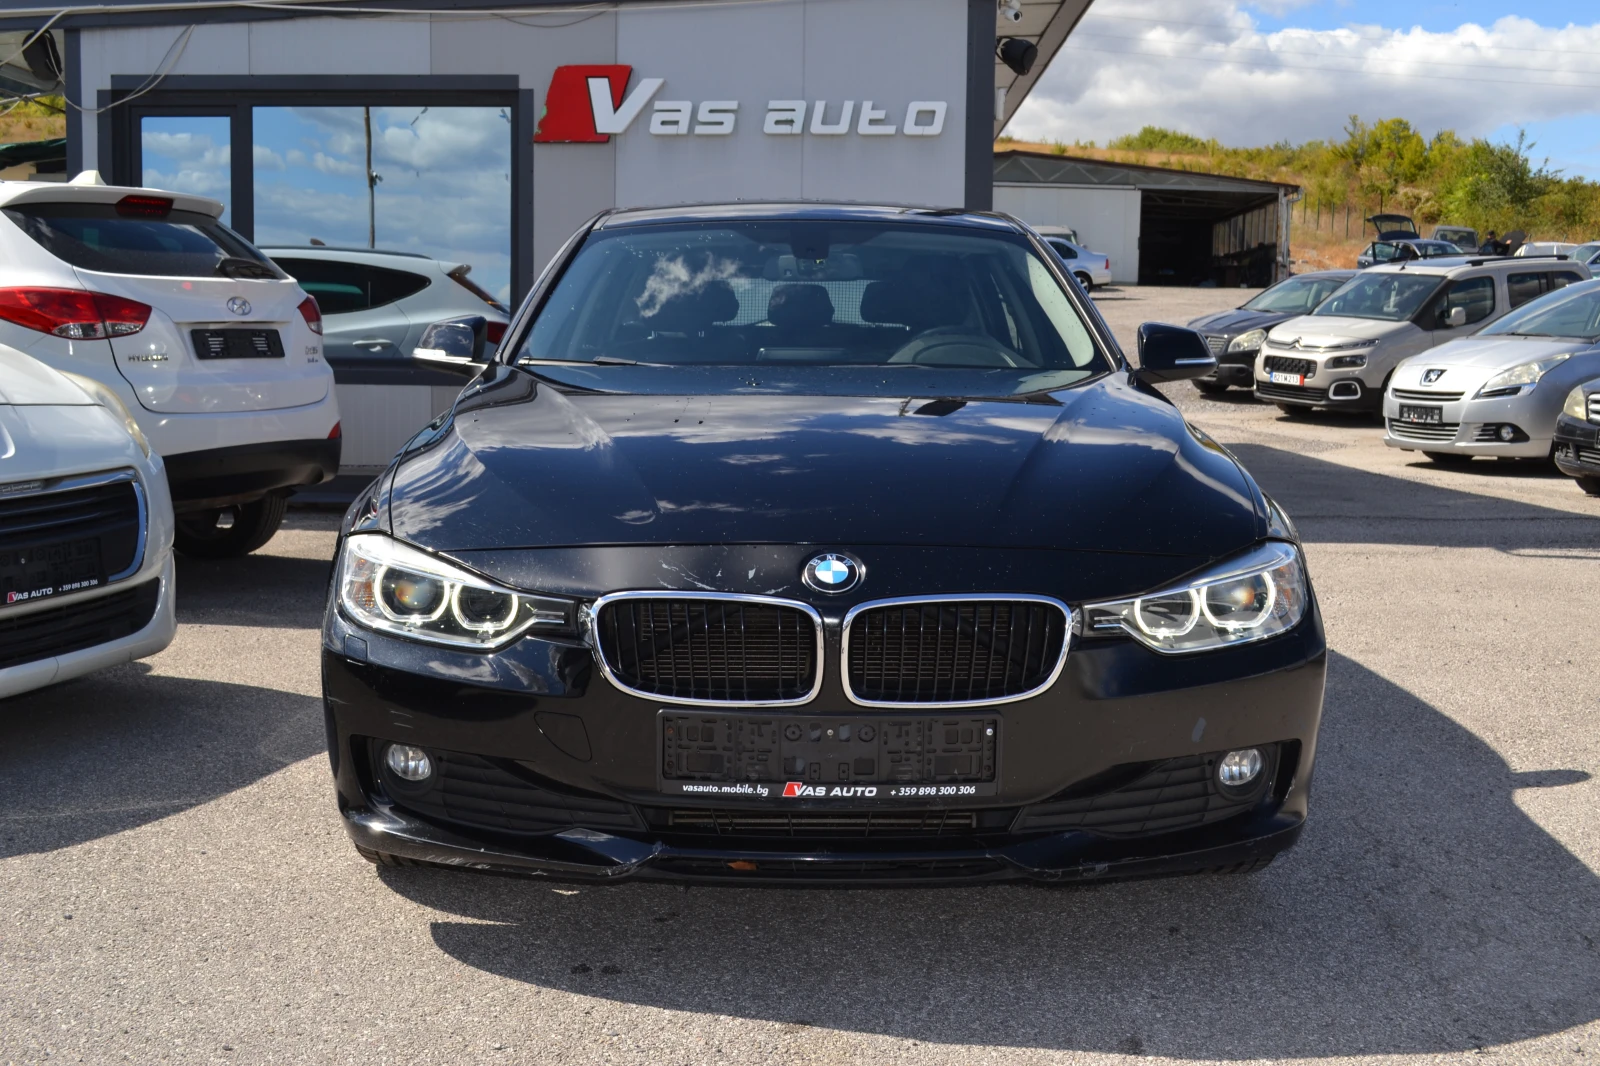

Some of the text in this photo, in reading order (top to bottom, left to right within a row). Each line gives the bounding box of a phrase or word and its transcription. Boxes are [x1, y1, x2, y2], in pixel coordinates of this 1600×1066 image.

[586, 77, 948, 136] Vas auto
[810, 554, 853, 567] BMW
[11, 592, 29, 601] VAS
[30, 587, 53, 598] AUTO
[682, 784, 769, 797] vasauto.mobile.bg
[793, 785, 877, 797] VAS AUTO
[898, 787, 917, 796] 359
[918, 786, 937, 796] 898
[938, 786, 956, 796] 300
[957, 785, 976, 795] 306
